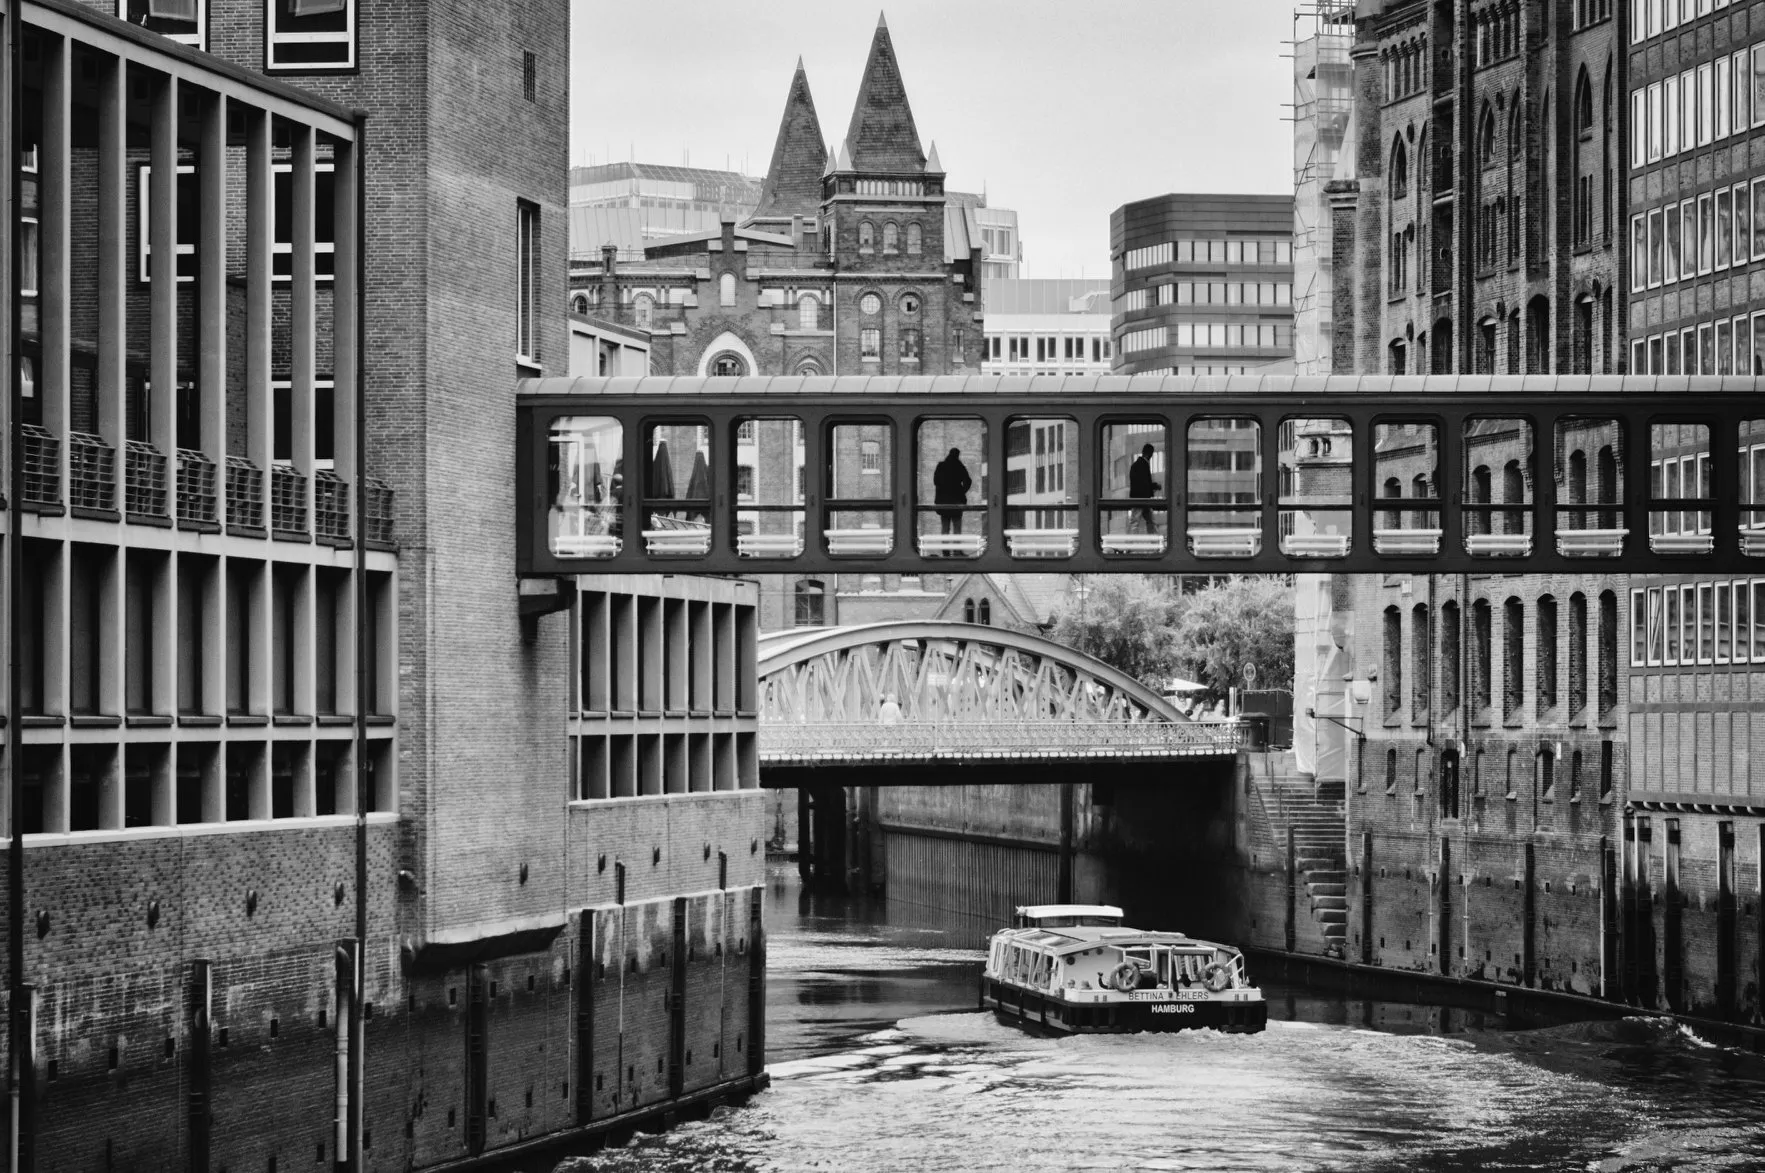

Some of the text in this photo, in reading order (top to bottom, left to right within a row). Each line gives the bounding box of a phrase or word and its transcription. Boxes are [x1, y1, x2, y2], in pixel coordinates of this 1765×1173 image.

[1128, 991, 1209, 1000] BETTINA EHLERS
[1151, 1004, 1195, 1013] HAMBURG
